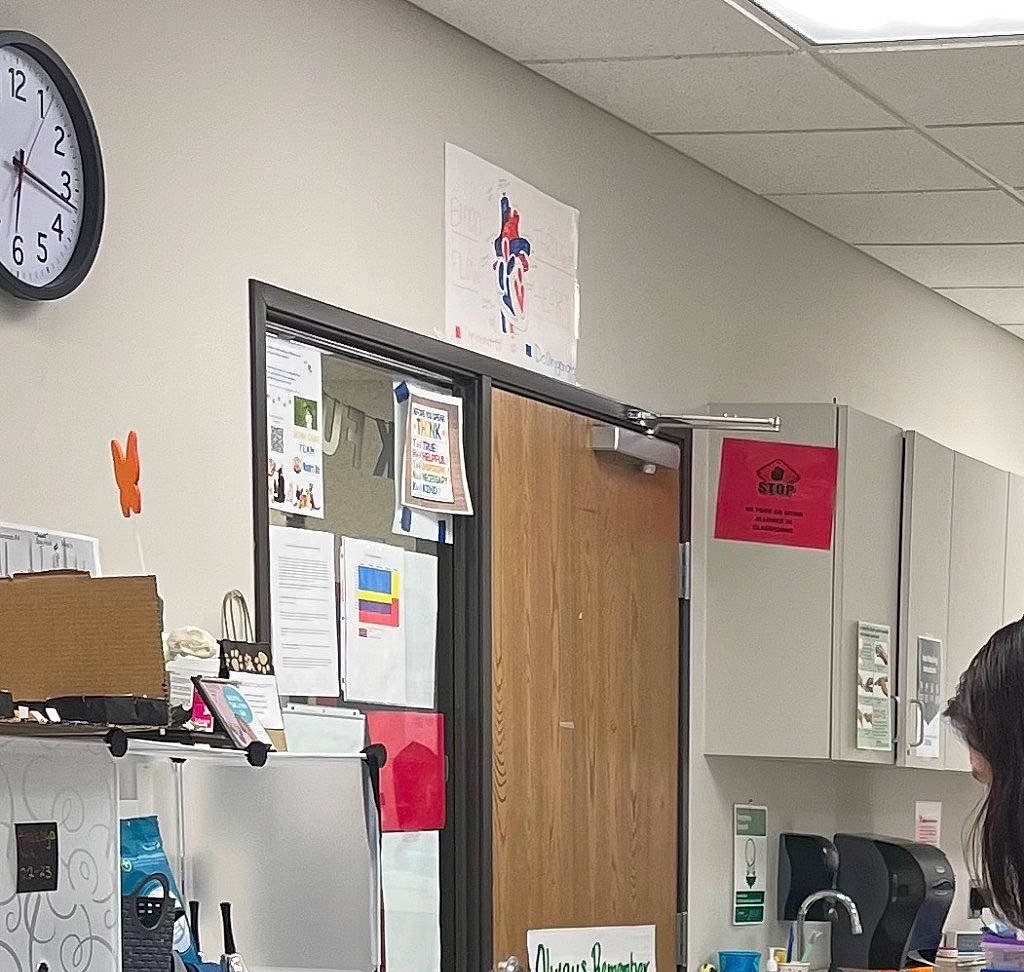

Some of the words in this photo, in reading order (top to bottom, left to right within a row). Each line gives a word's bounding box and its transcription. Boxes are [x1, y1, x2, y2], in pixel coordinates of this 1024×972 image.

[8, 67, 27, 102] 12
[37, 89, 46, 119] 1
[54, 125, 66, 156] 2
[60, 170, 72, 201] 3
[51, 213, 64, 241] 4
[12, 235, 24, 265] 6
[36, 232, 48, 263] 5
[758, 481, 796, 496] STOP
